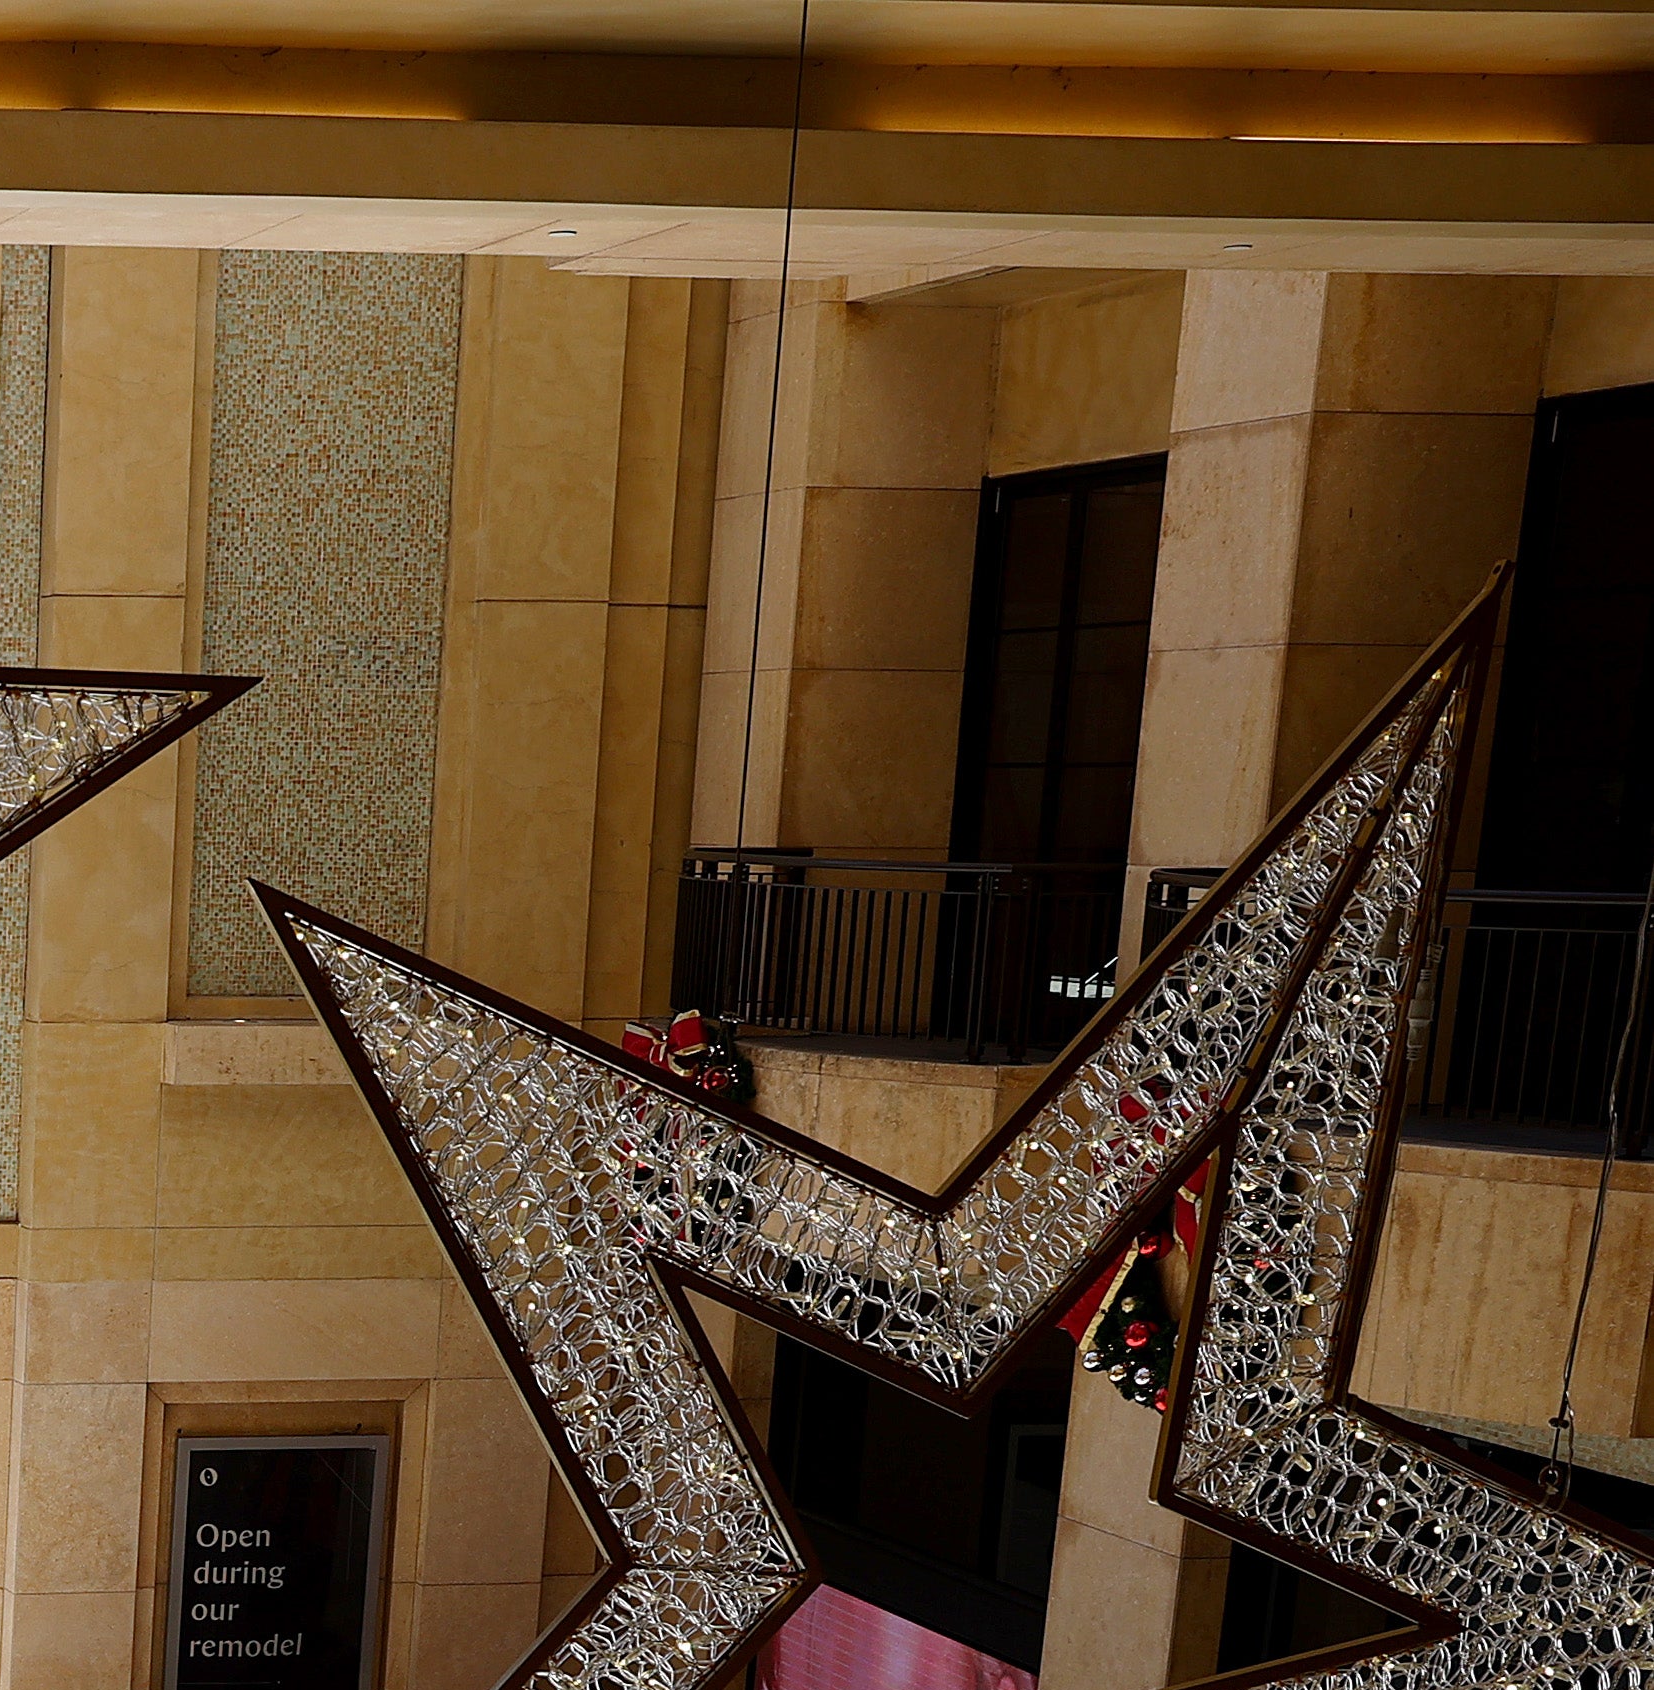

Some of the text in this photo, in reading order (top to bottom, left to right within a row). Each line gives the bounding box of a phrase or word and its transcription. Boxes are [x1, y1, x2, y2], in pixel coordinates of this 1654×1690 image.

[196, 1523, 271, 1552] Open
[194, 1560, 285, 1589] during
[191, 1603, 240, 1621] our
[189, 1633, 302, 1658] remodel
